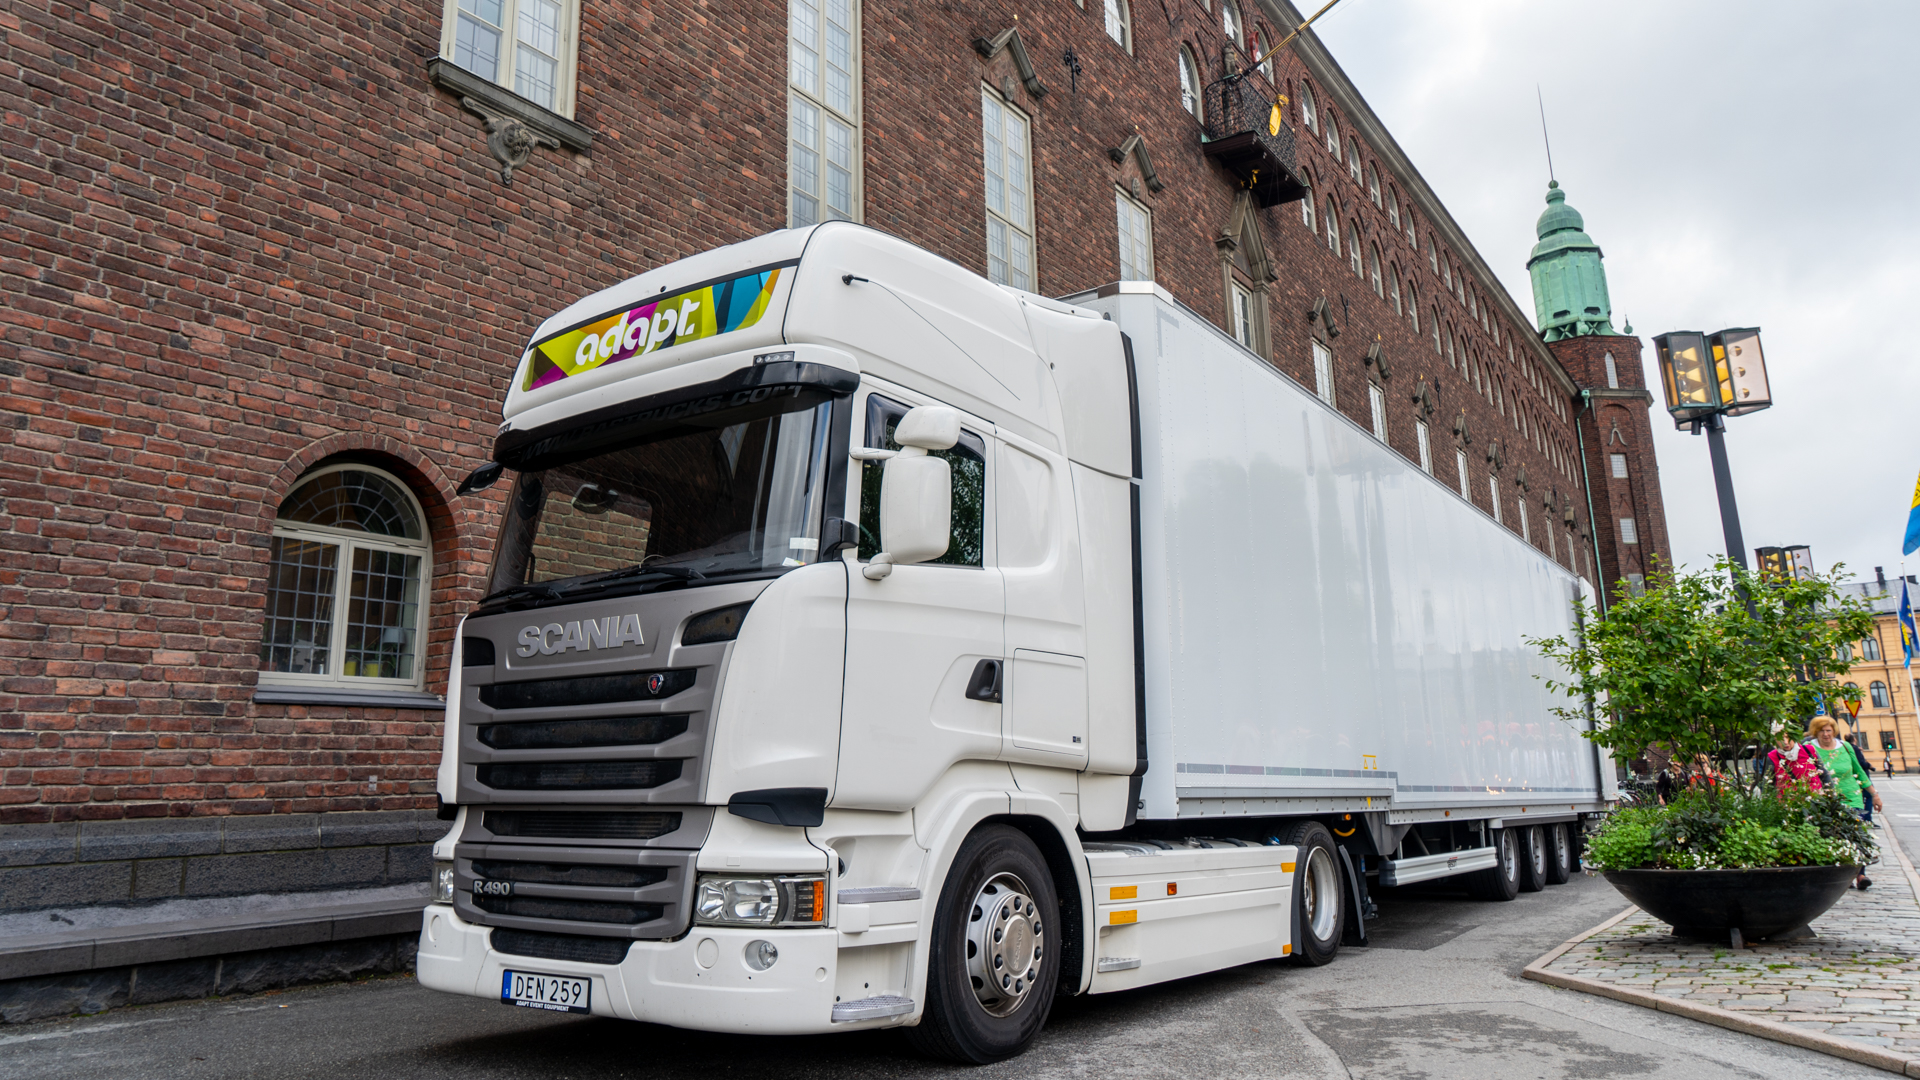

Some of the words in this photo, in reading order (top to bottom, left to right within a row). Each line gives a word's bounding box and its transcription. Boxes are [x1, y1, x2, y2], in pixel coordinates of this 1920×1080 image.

[516, 613, 645, 658] SCANIA
[473, 880, 484, 894] R
[483, 881, 511, 896] 490
[515, 975, 546, 1000] DEN
[549, 979, 582, 1004] 259
[515, 1000, 530, 1008] ADAPT
[529, 1001, 544, 1009] EVENT
[543, 1003, 570, 1012] EQUIPMENT
